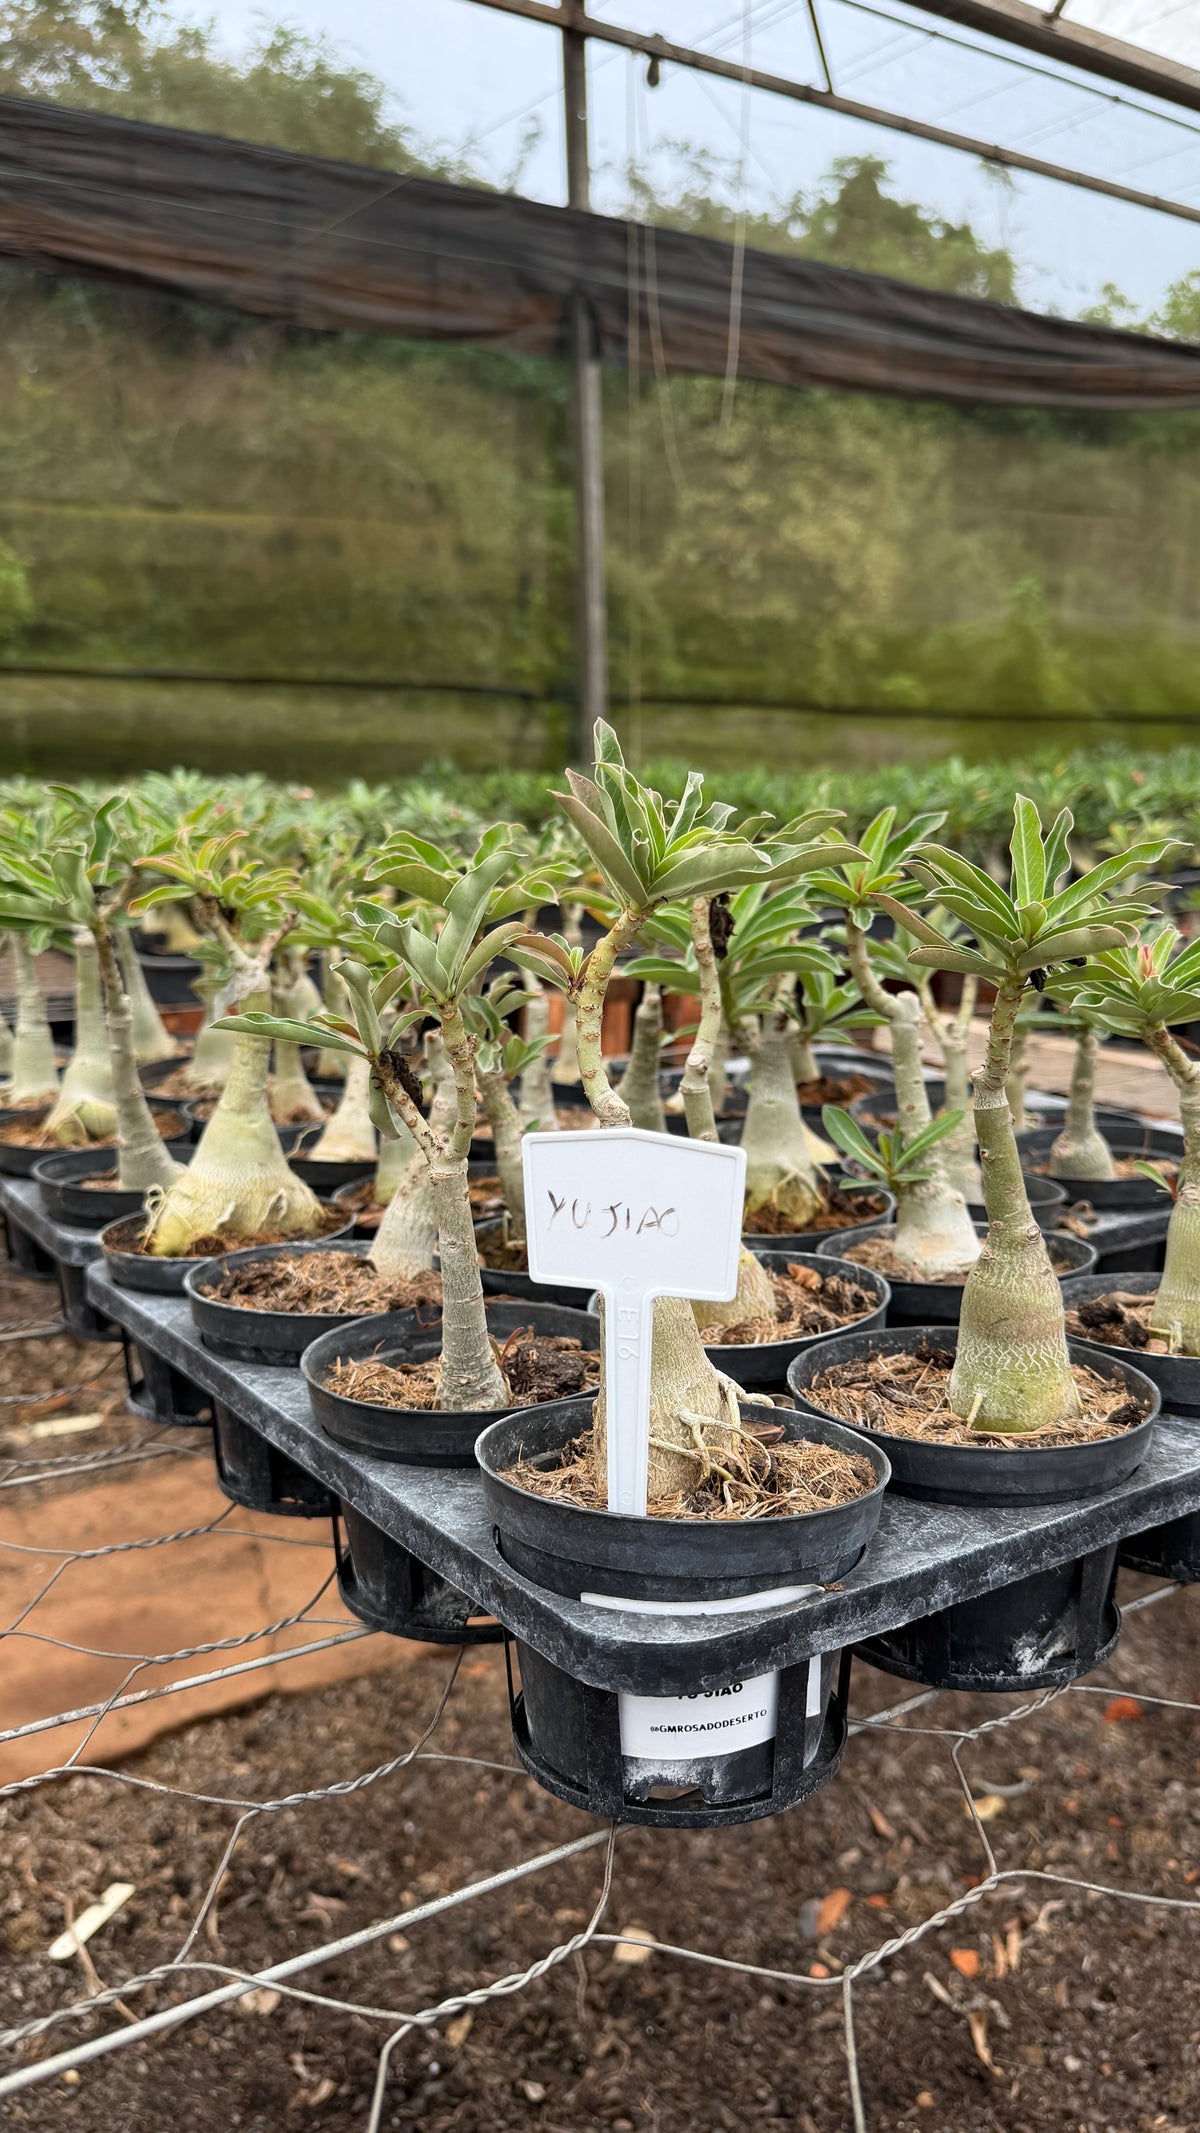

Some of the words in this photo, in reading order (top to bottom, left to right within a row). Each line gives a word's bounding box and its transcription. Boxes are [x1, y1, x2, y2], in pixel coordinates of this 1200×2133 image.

[546, 1189, 592, 1231] YU
[600, 1201, 680, 1239] JIAO
[650, 1709, 767, 1732] @GMROSADODESERTO
